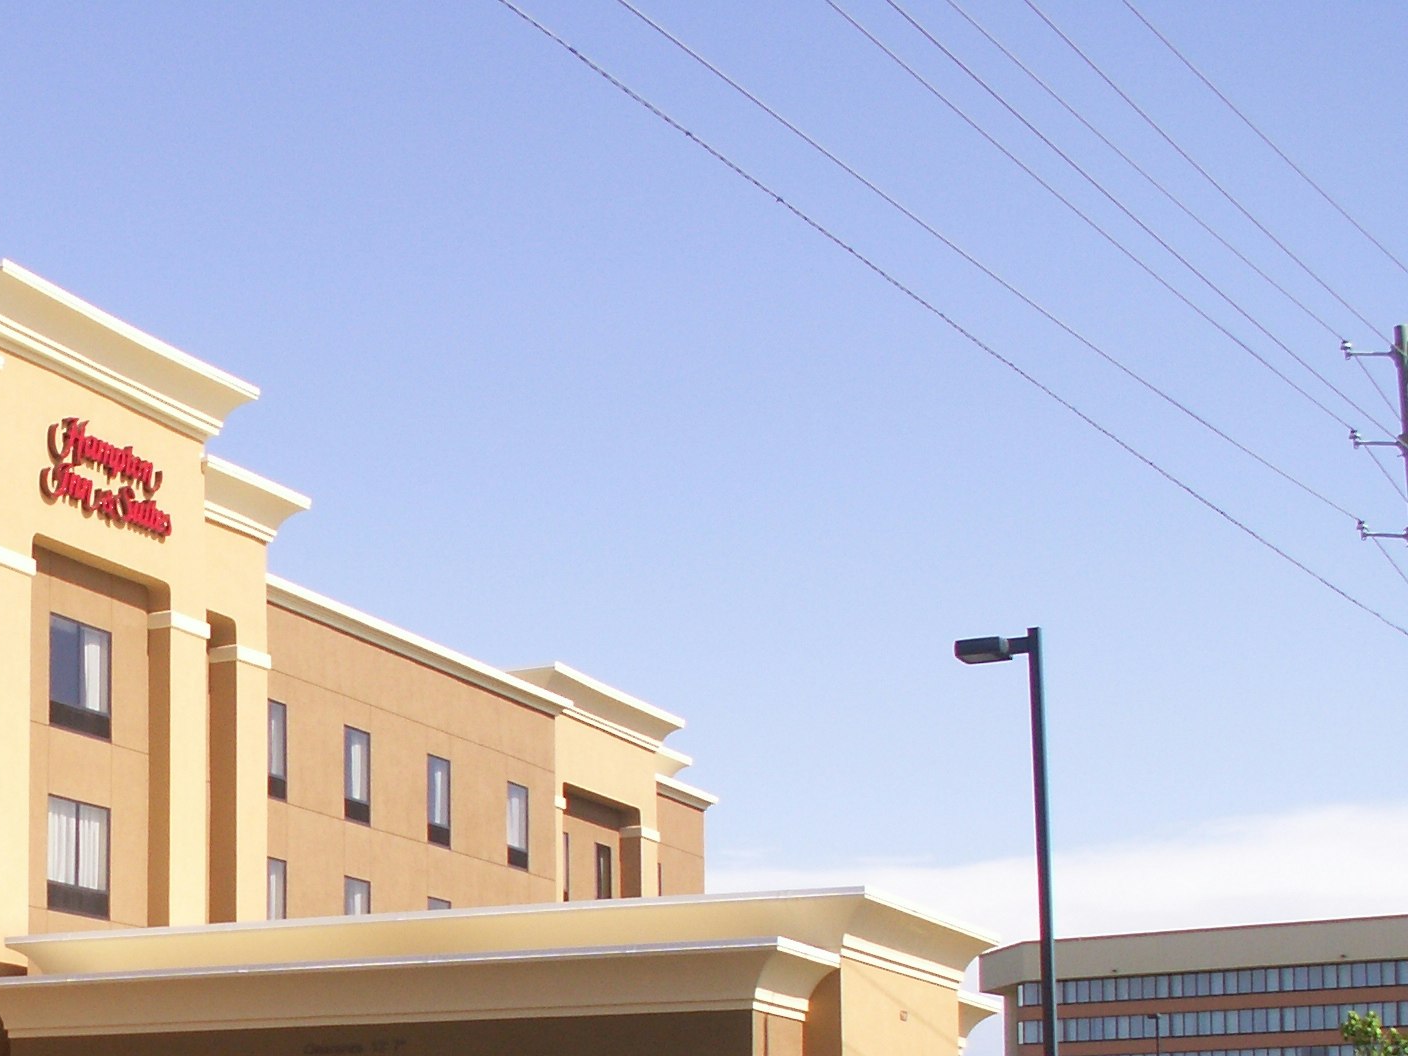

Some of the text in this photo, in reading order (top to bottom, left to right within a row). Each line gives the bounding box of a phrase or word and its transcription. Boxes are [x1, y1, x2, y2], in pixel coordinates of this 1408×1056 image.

[47, 417, 163, 498] Hampton
[39, 463, 95, 518] Inn
[112, 486, 172, 537] Suites
